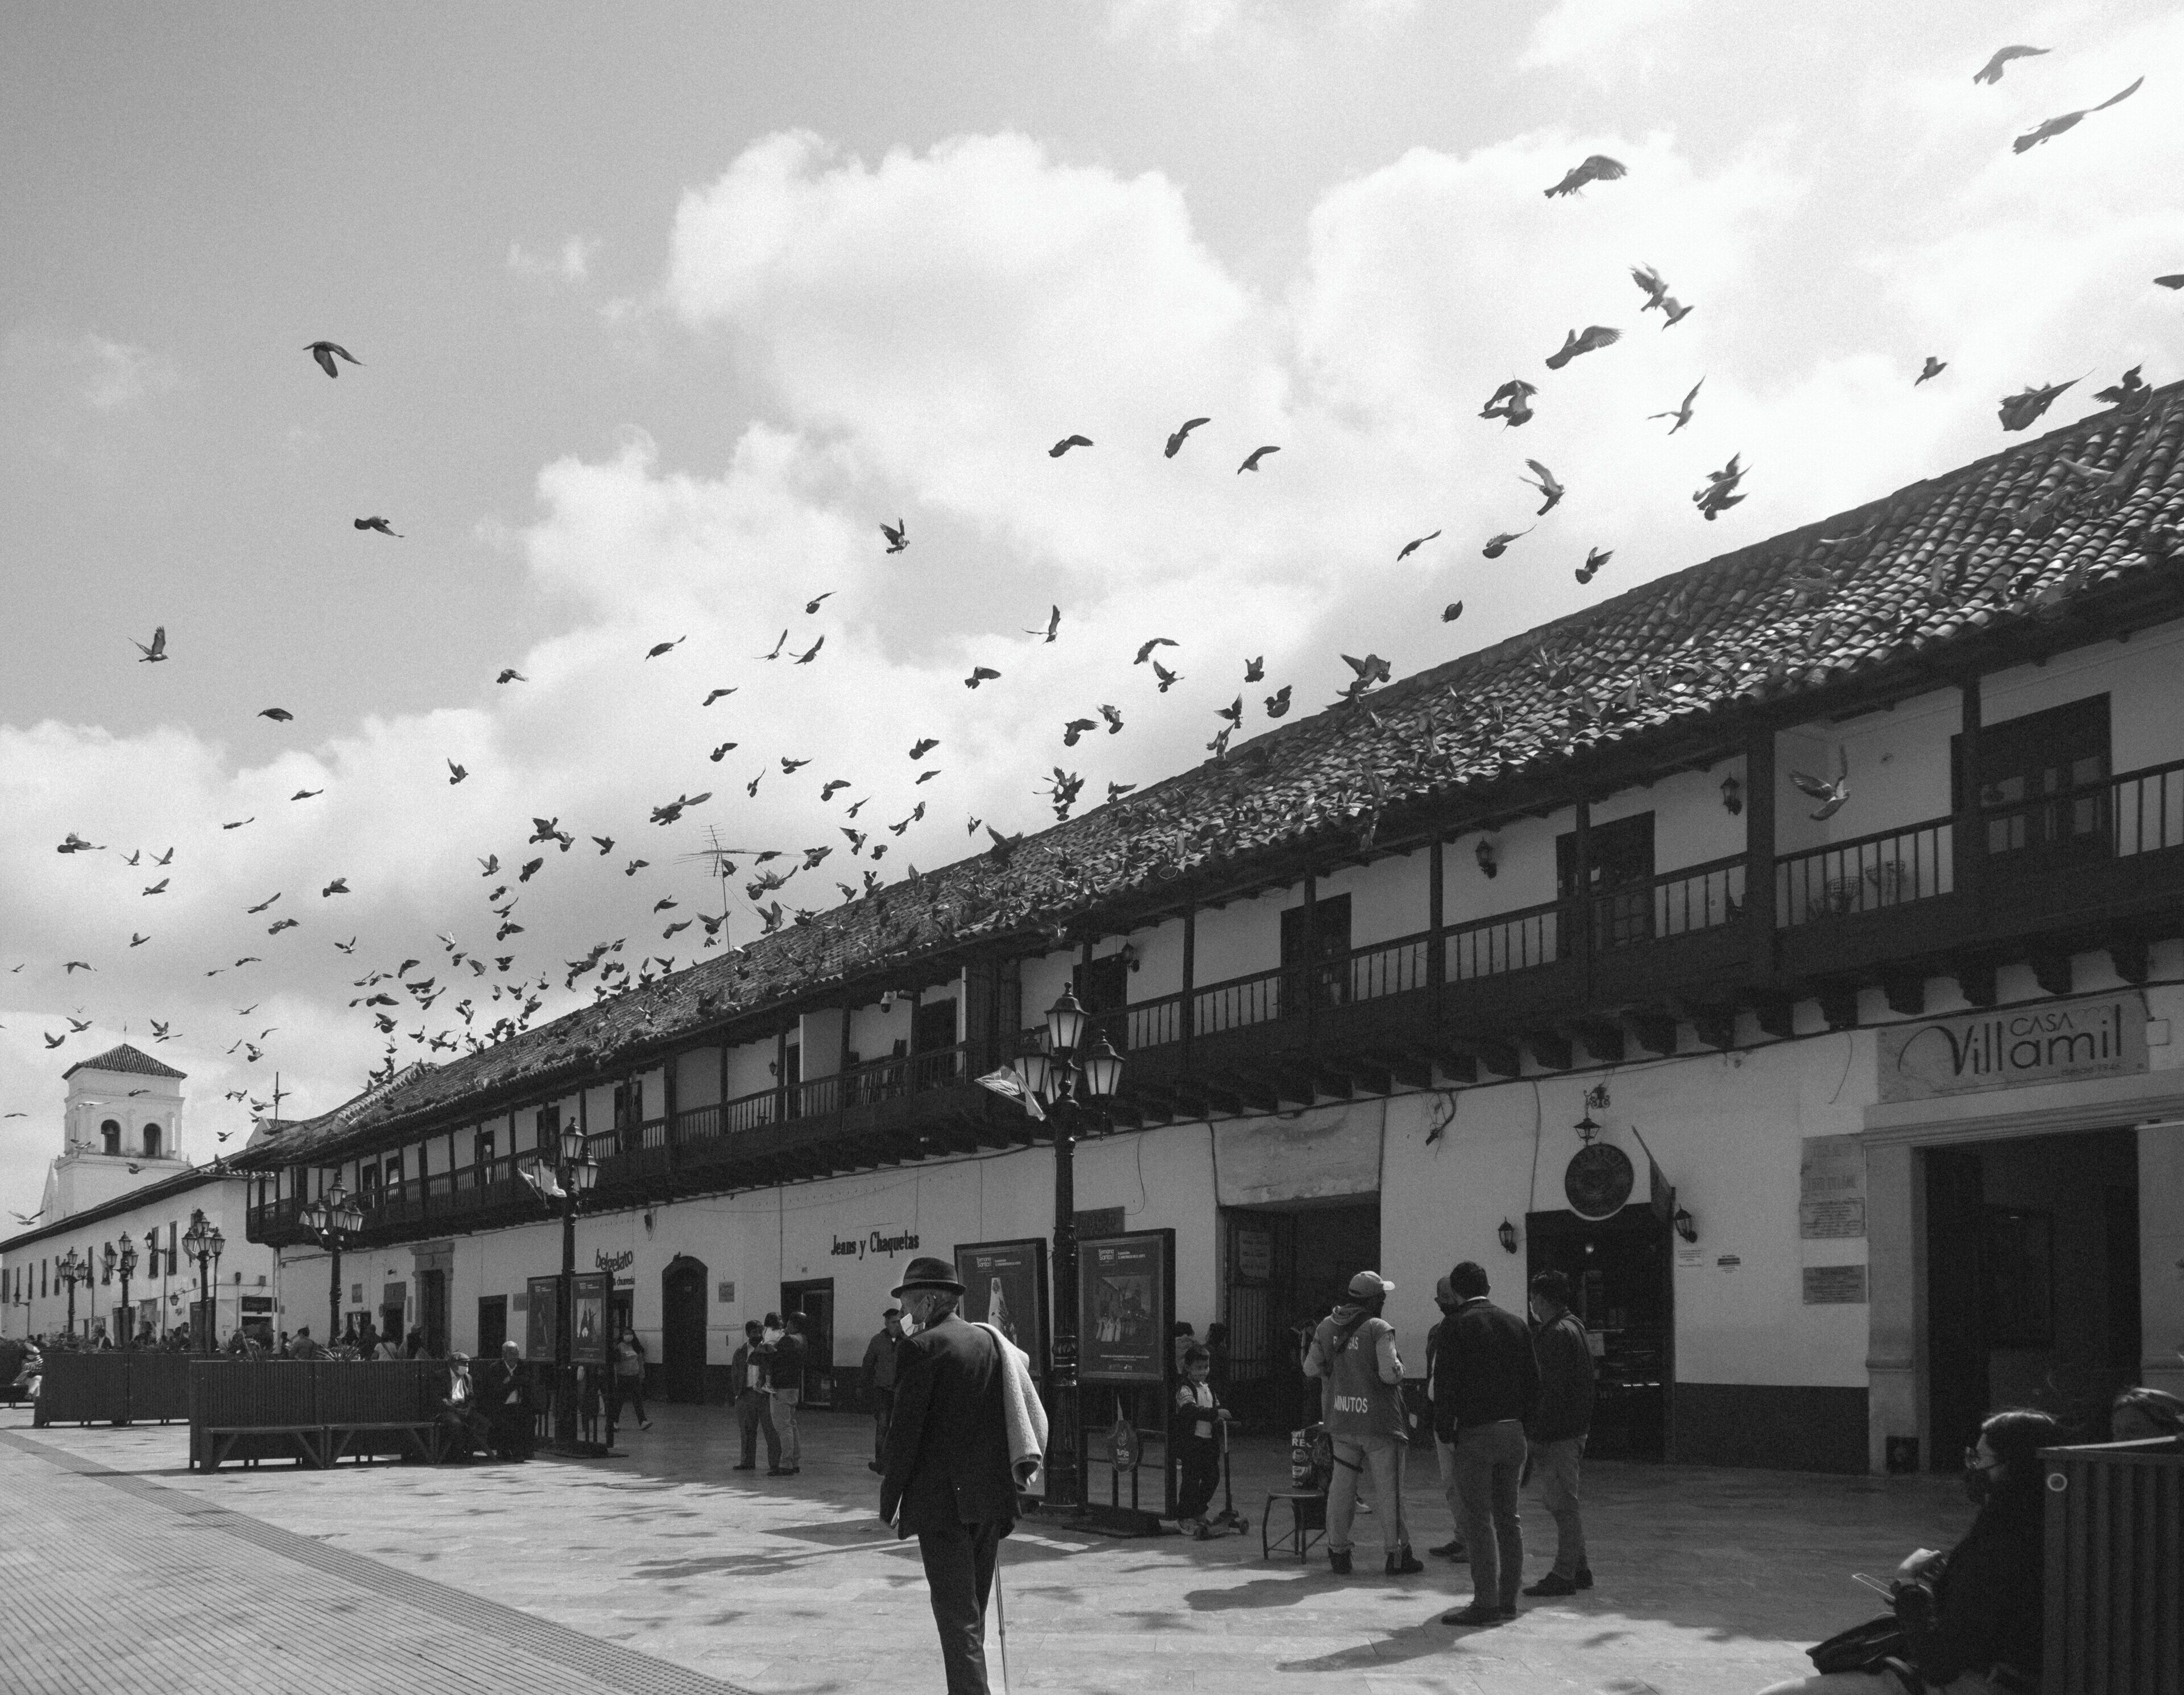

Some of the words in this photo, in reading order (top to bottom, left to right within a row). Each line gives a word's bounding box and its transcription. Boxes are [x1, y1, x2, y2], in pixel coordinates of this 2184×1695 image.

[2009, 1013, 2074, 1036] CASA
[1897, 1004, 2122, 1076] Villamil
[831, 1234, 856, 1255] Jeans
[858, 1240, 866, 1260] y
[870, 1230, 920, 1258] Chaquetas
[1334, 1395, 1368, 1413] MINUTOS
